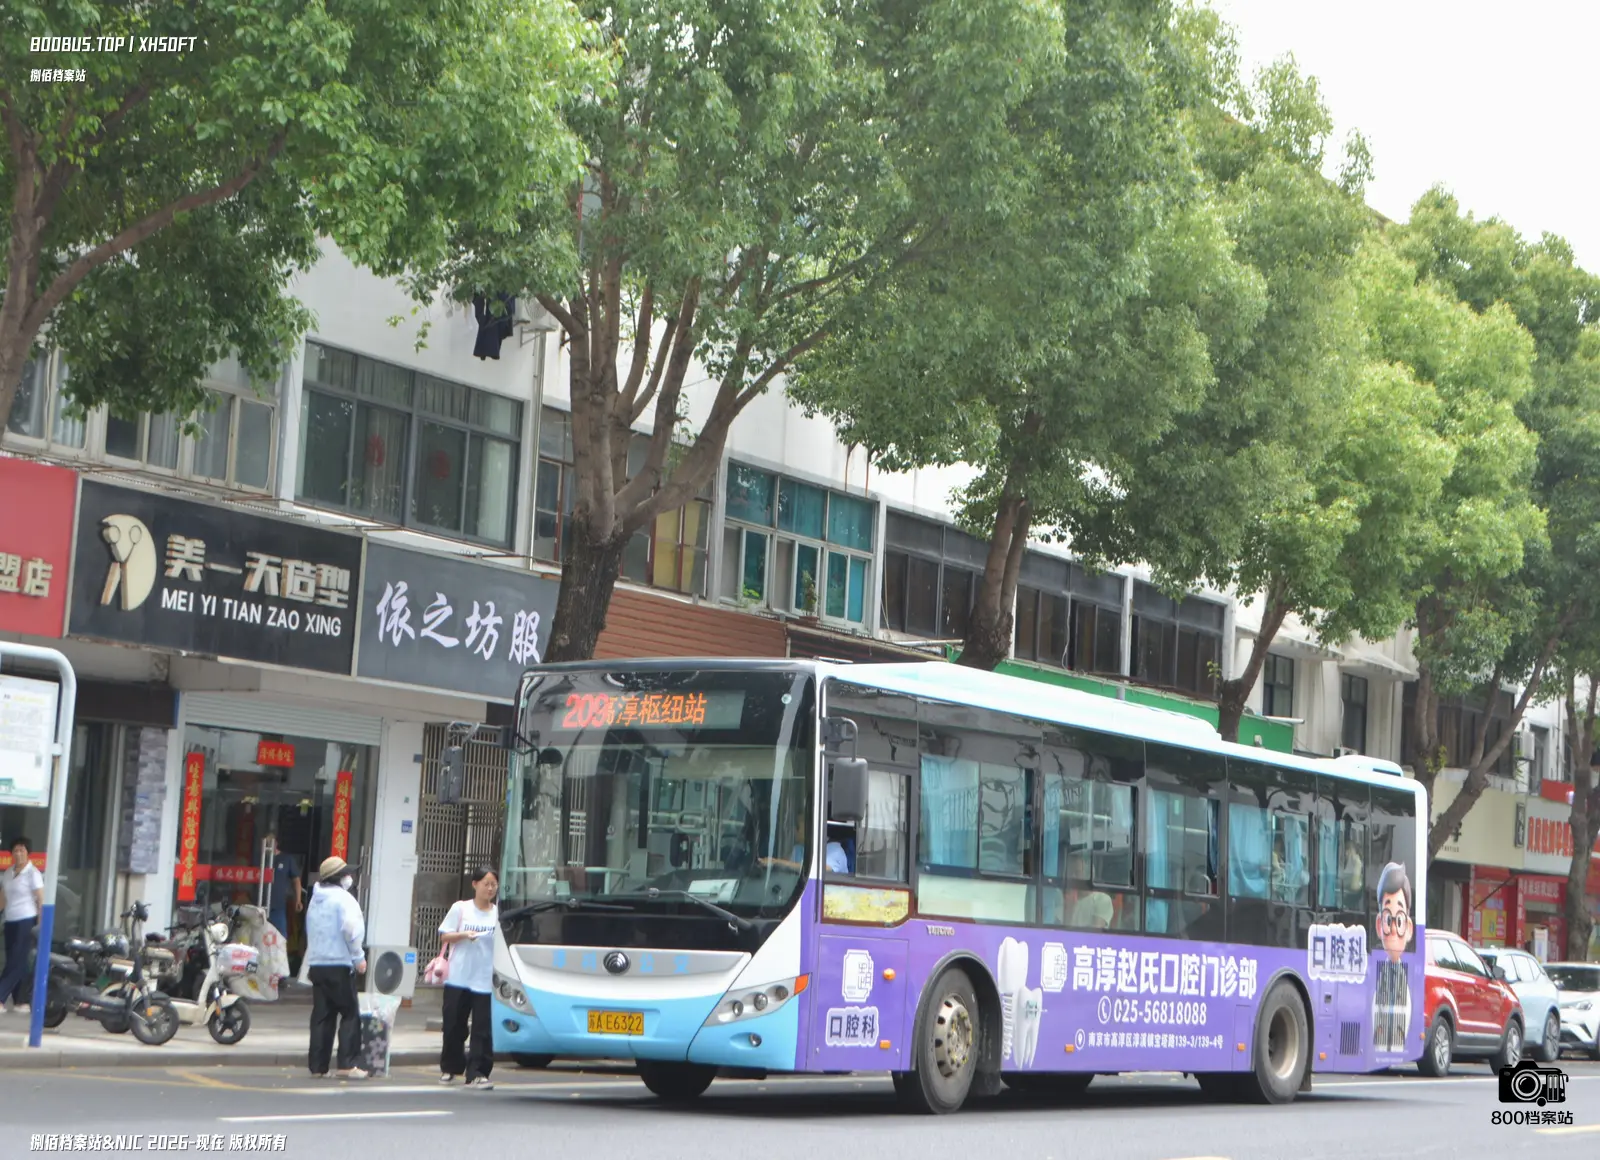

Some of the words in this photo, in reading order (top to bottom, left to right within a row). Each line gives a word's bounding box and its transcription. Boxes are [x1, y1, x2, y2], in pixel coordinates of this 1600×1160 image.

[164, 533, 350, 609] 美一天造型
[161, 587, 194, 612] MEI
[201, 594, 217, 616] YI
[223, 598, 262, 624] TIAN
[266, 606, 300, 630] ZAO
[304, 612, 342, 637] XING
[562, 692, 609, 729] 209
[1073, 945, 1258, 1000] 高淳赵氏口腔门诊部
[1313, 934, 1363, 973] 口腔科
[830, 1013, 875, 1039] 口腔科
[1113, 999, 1207, 1025] 025-56818088
